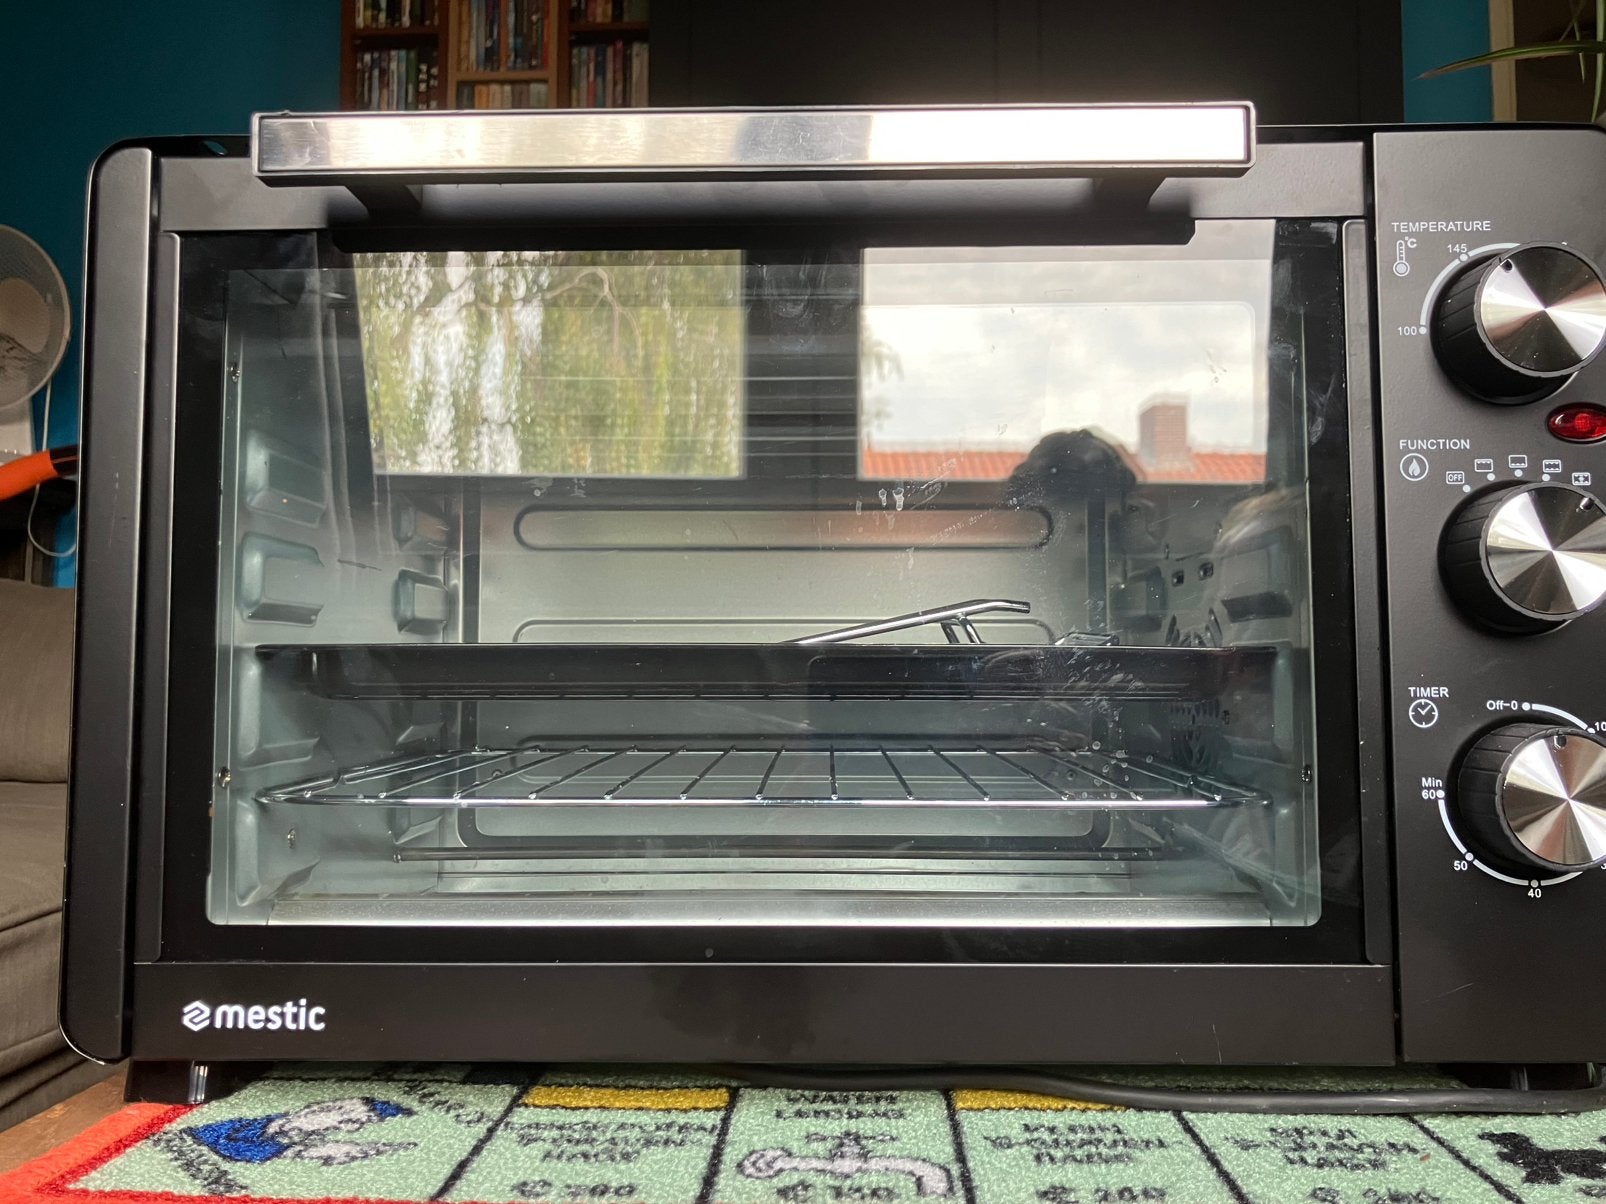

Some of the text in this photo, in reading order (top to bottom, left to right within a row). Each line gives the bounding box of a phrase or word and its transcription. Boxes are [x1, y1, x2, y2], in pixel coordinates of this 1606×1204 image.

[1391, 220, 1492, 233] TEMPERATURE
[1447, 243, 1468, 253] 145
[1397, 326, 1418, 336] 100
[1399, 438, 1471, 450] FUNCTION
[1447, 473, 1463, 482] OFF
[1408, 687, 1449, 698] TIMER
[1486, 700, 1518, 711] Off-0
[1421, 777, 1442, 788] Min
[1421, 789, 1436, 800] 60
[1453, 860, 1468, 871] 50
[1527, 888, 1542, 898] 40
[214, 998, 326, 1031] mestic
